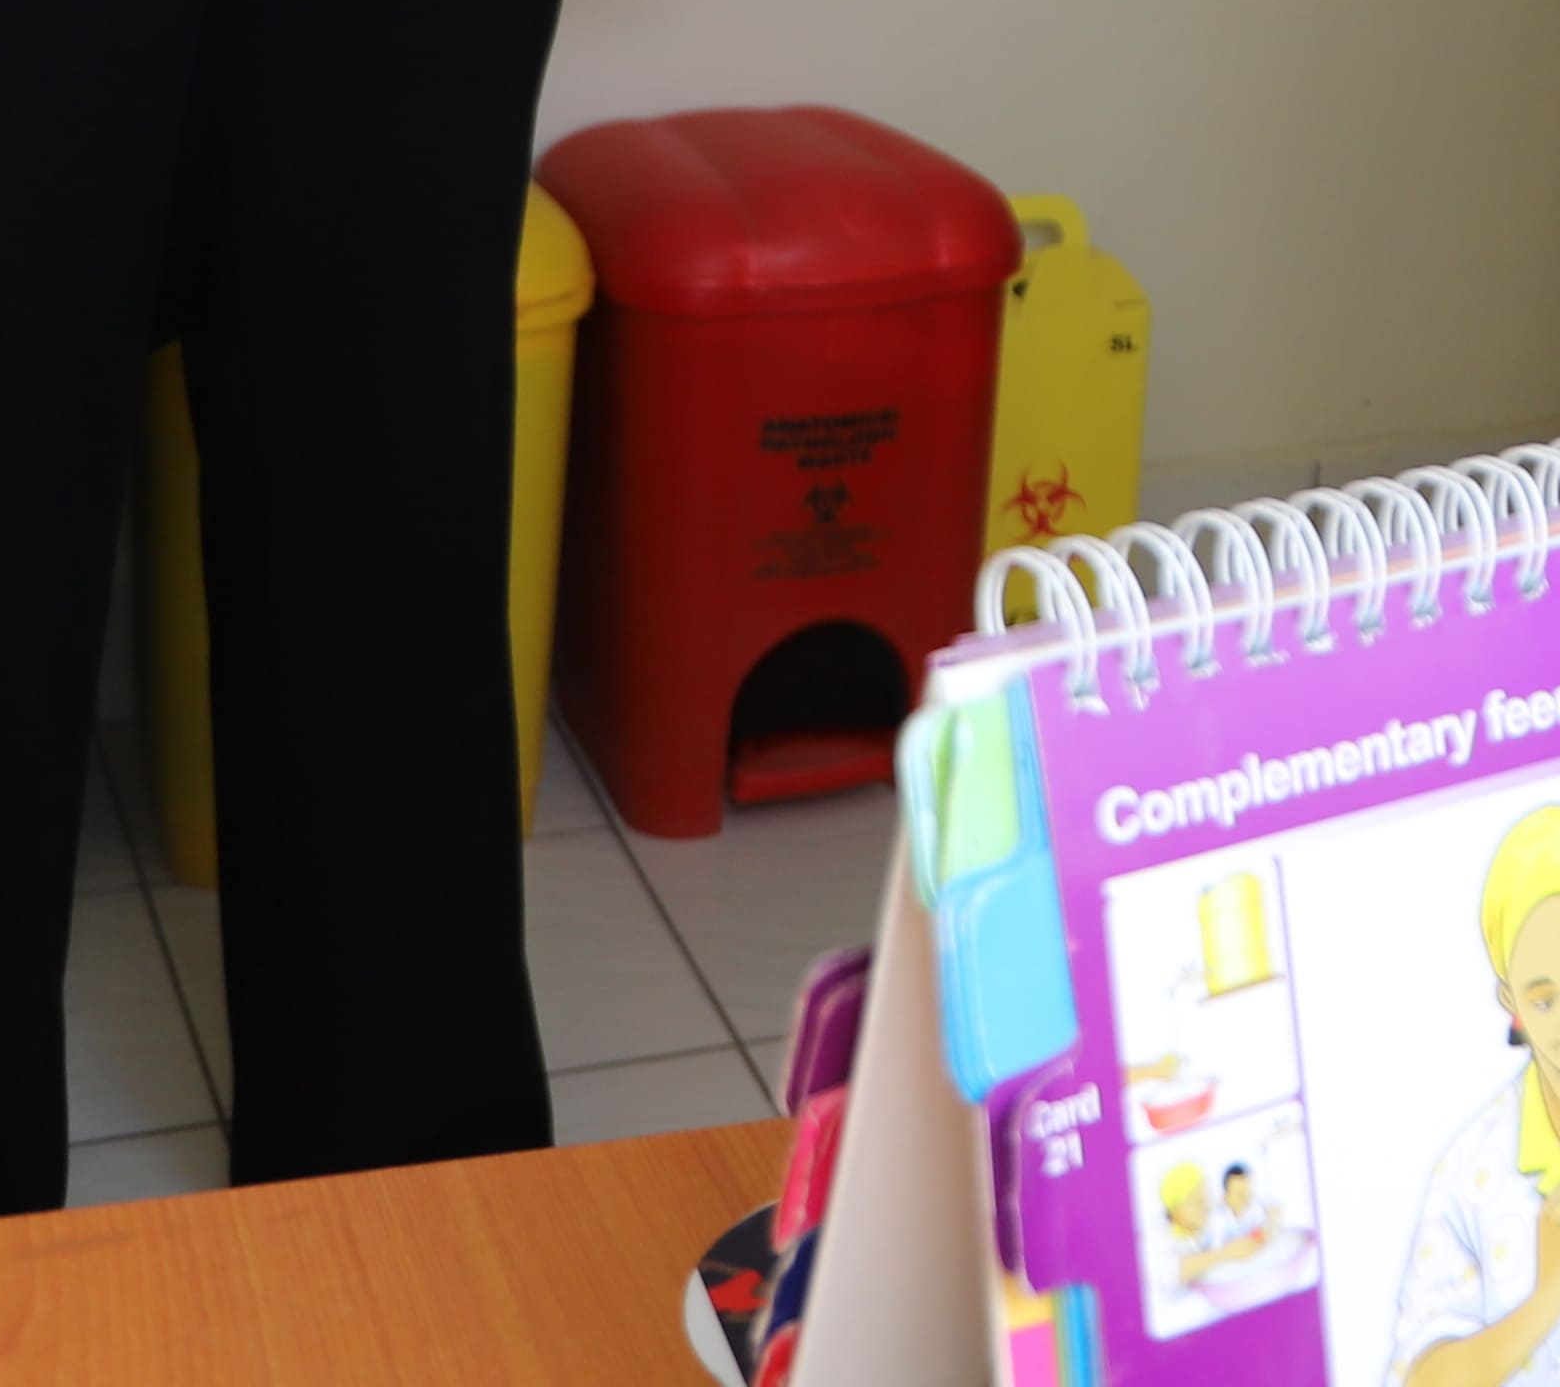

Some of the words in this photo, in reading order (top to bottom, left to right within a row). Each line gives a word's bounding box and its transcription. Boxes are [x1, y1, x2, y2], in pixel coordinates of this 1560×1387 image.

[1095, 709, 1477, 847] Complementary
[1028, 1080, 1102, 1140] Card
[1043, 1131, 1083, 1177] 21
